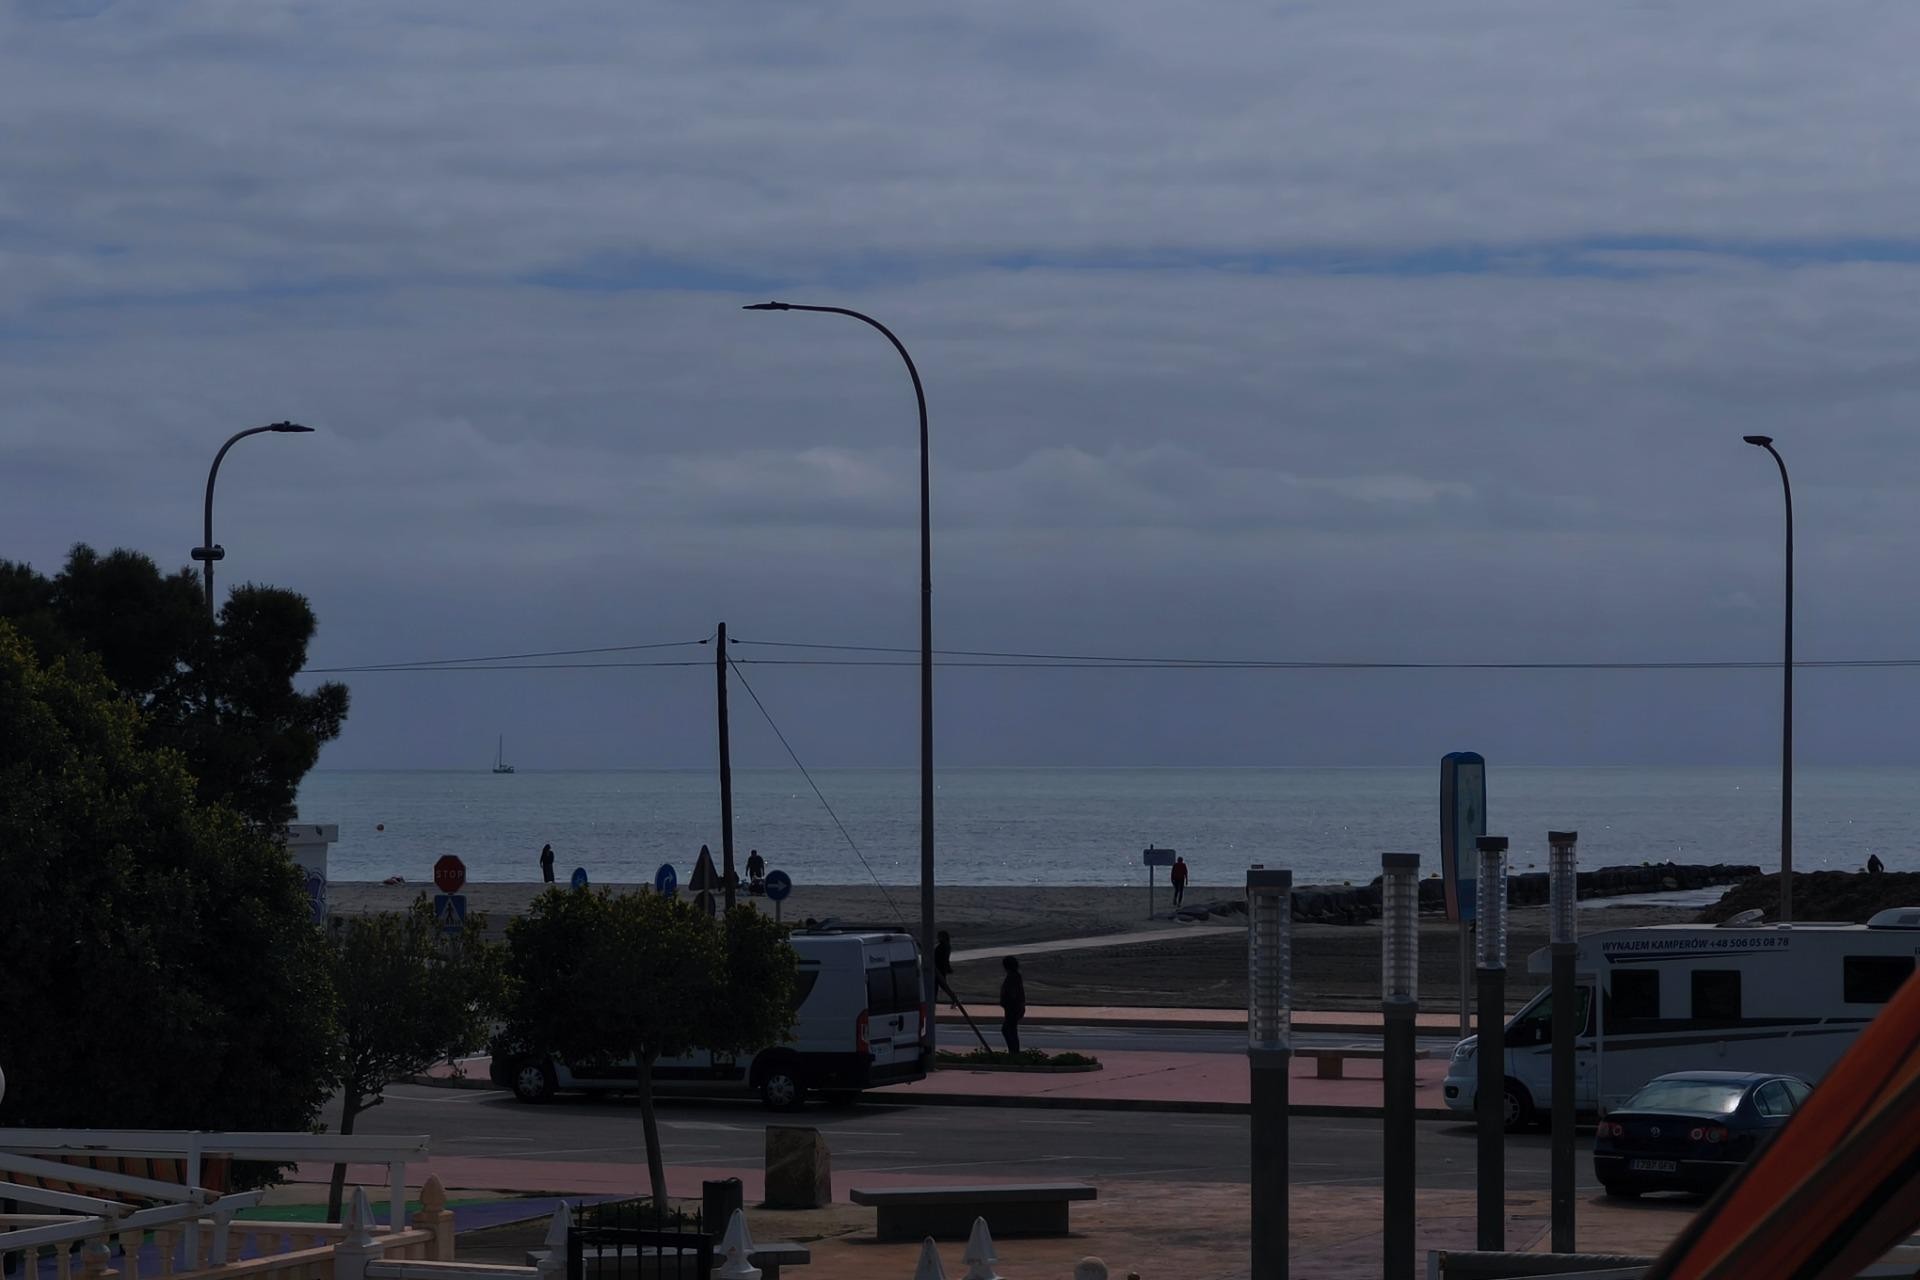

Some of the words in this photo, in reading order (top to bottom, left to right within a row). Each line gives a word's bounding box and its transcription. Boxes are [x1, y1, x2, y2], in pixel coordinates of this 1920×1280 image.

[436, 870, 463, 880] STOP
[1602, 940, 1649, 951] WYNAJEM
[1710, 939, 1728, 948] +48
[1729, 938, 1748, 947] 506
[1749, 938, 1761, 947] 05
